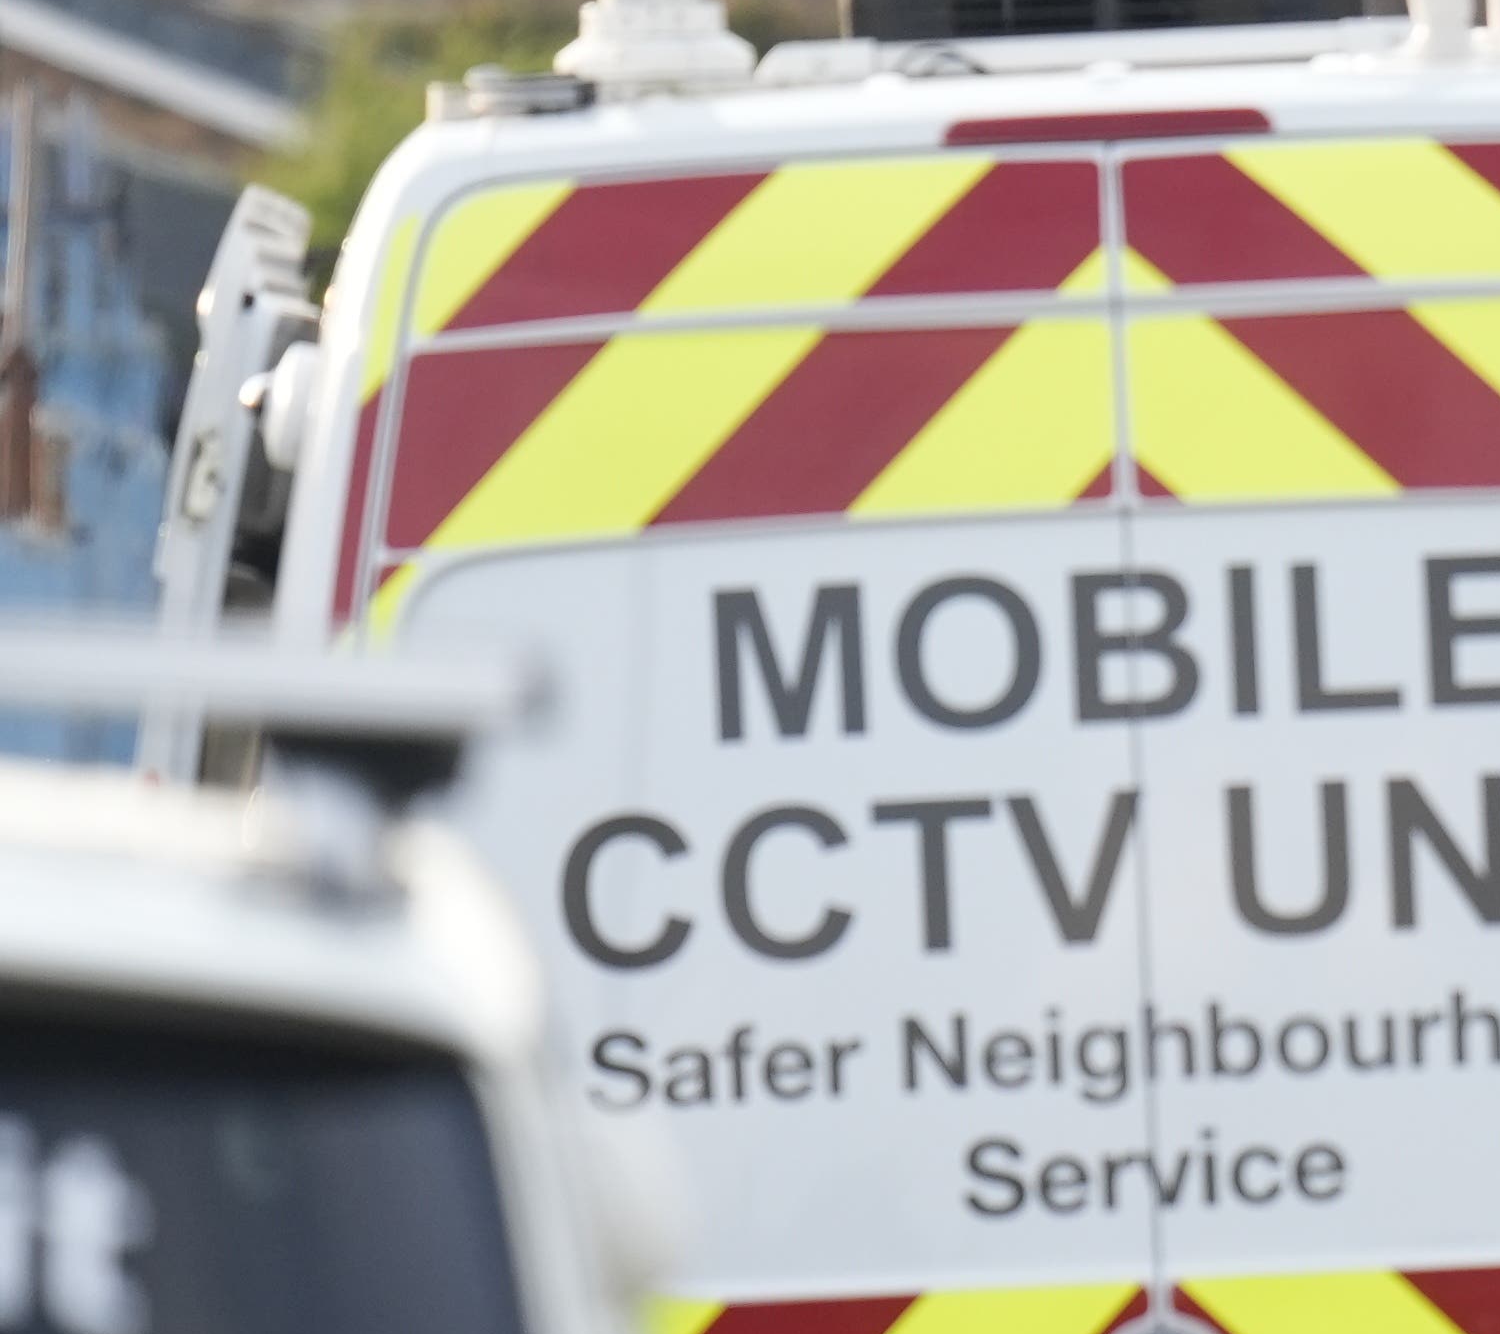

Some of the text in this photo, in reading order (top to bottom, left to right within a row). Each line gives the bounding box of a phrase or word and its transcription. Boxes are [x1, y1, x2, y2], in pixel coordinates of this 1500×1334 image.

[562, 790, 1140, 971] CCTV
[587, 1019, 862, 1110] Safer
[963, 1137, 1350, 1218] Service
